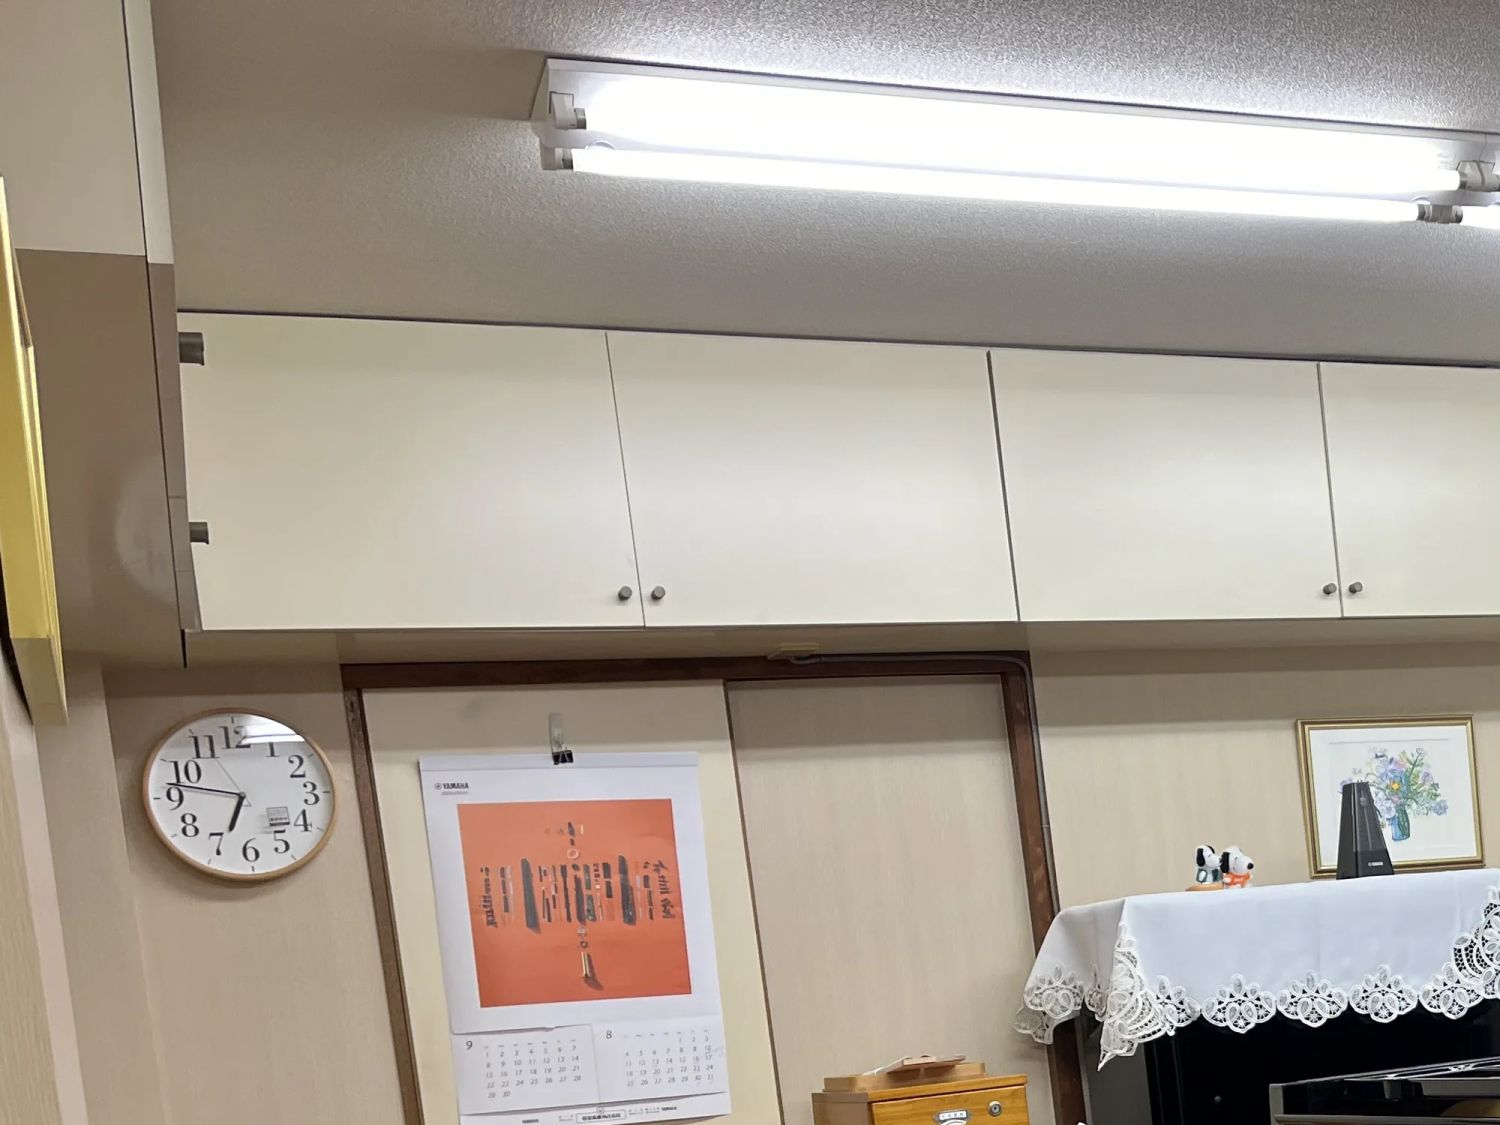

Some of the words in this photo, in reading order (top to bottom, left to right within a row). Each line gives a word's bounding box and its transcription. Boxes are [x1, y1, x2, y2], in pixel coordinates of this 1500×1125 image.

[188, 735, 220, 759] 11
[218, 725, 251, 750] 12
[266, 742, 280, 757] 1
[168, 760, 202, 784] 10
[288, 754, 306, 778] 2
[303, 781, 320, 805] 3
[442, 782, 469, 790] YAMAHA
[166, 786, 184, 811] 9
[180, 812, 199, 837] 8
[293, 808, 312, 832] 4
[208, 832, 224, 856] 7
[242, 838, 260, 862] 6
[273, 829, 290, 854] 5
[466, 1040, 473, 1050] 9
[606, 1030, 613, 1039] 8
